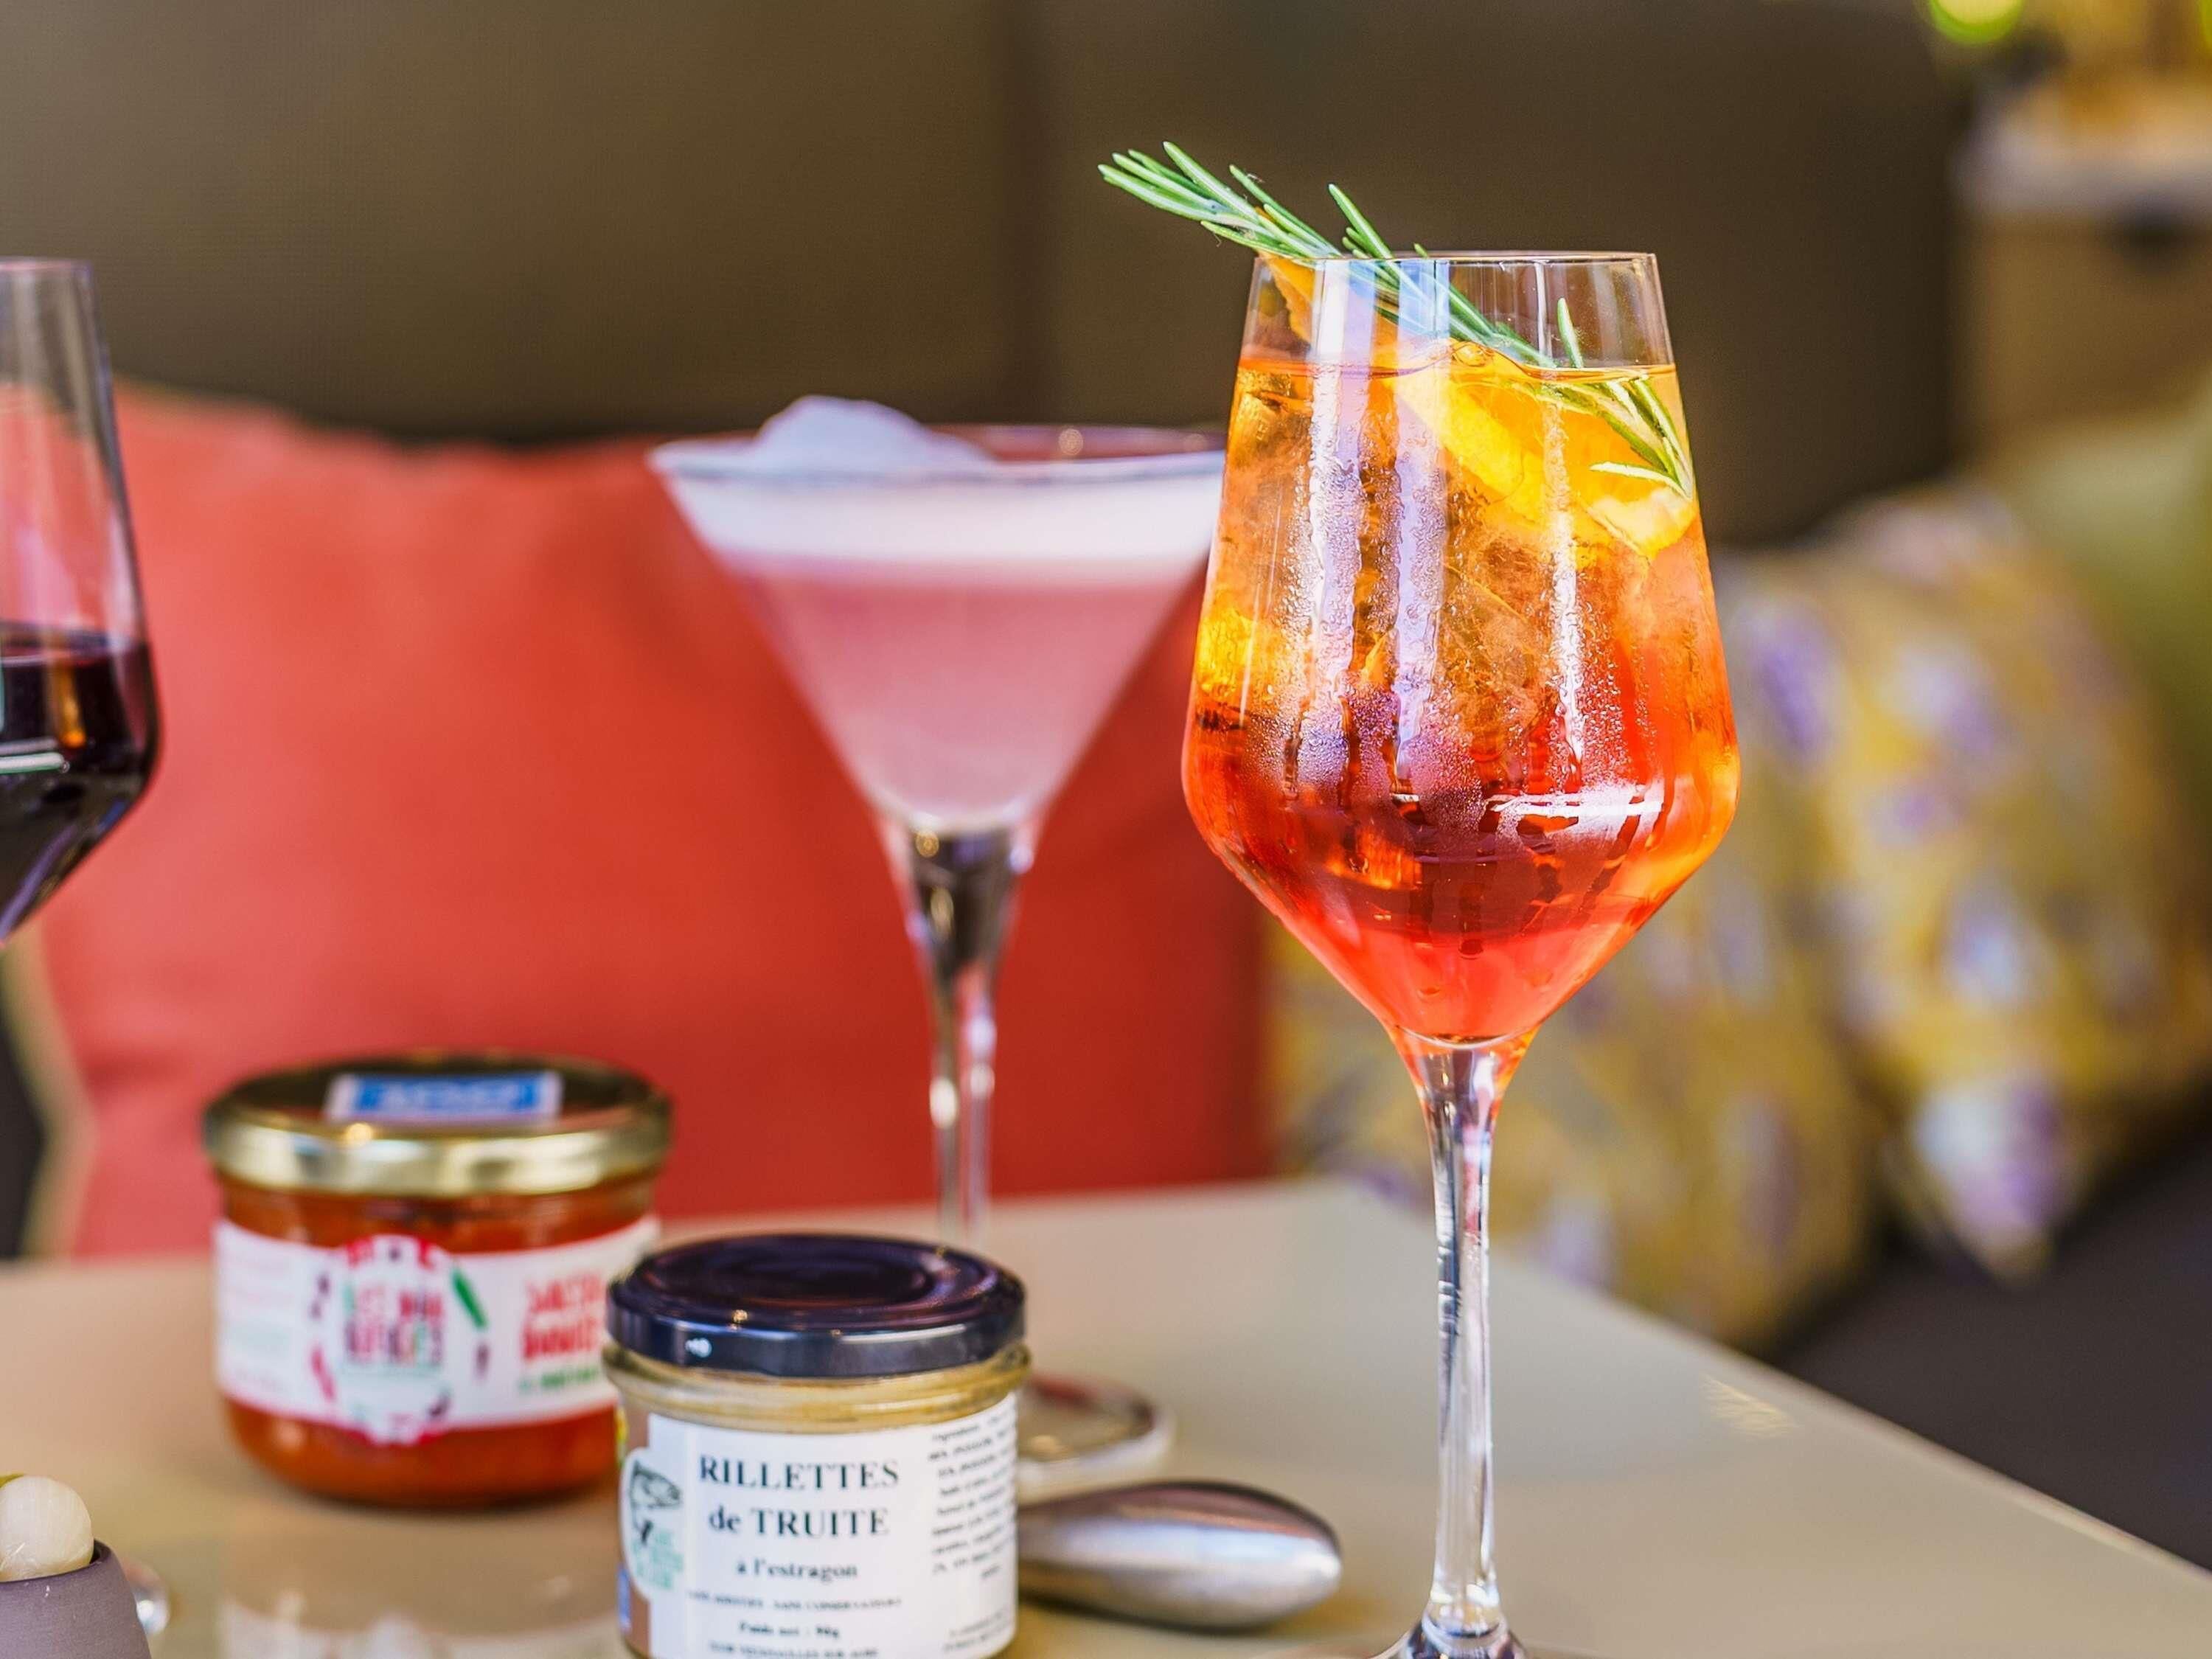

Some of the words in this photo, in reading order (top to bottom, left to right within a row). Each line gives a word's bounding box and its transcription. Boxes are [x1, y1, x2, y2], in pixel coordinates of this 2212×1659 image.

[700, 1455, 899, 1490] RILLETTES
[709, 1503, 741, 1533] de
[750, 1507, 889, 1537] TRUITE
[754, 1558, 858, 1585] l'estragon
